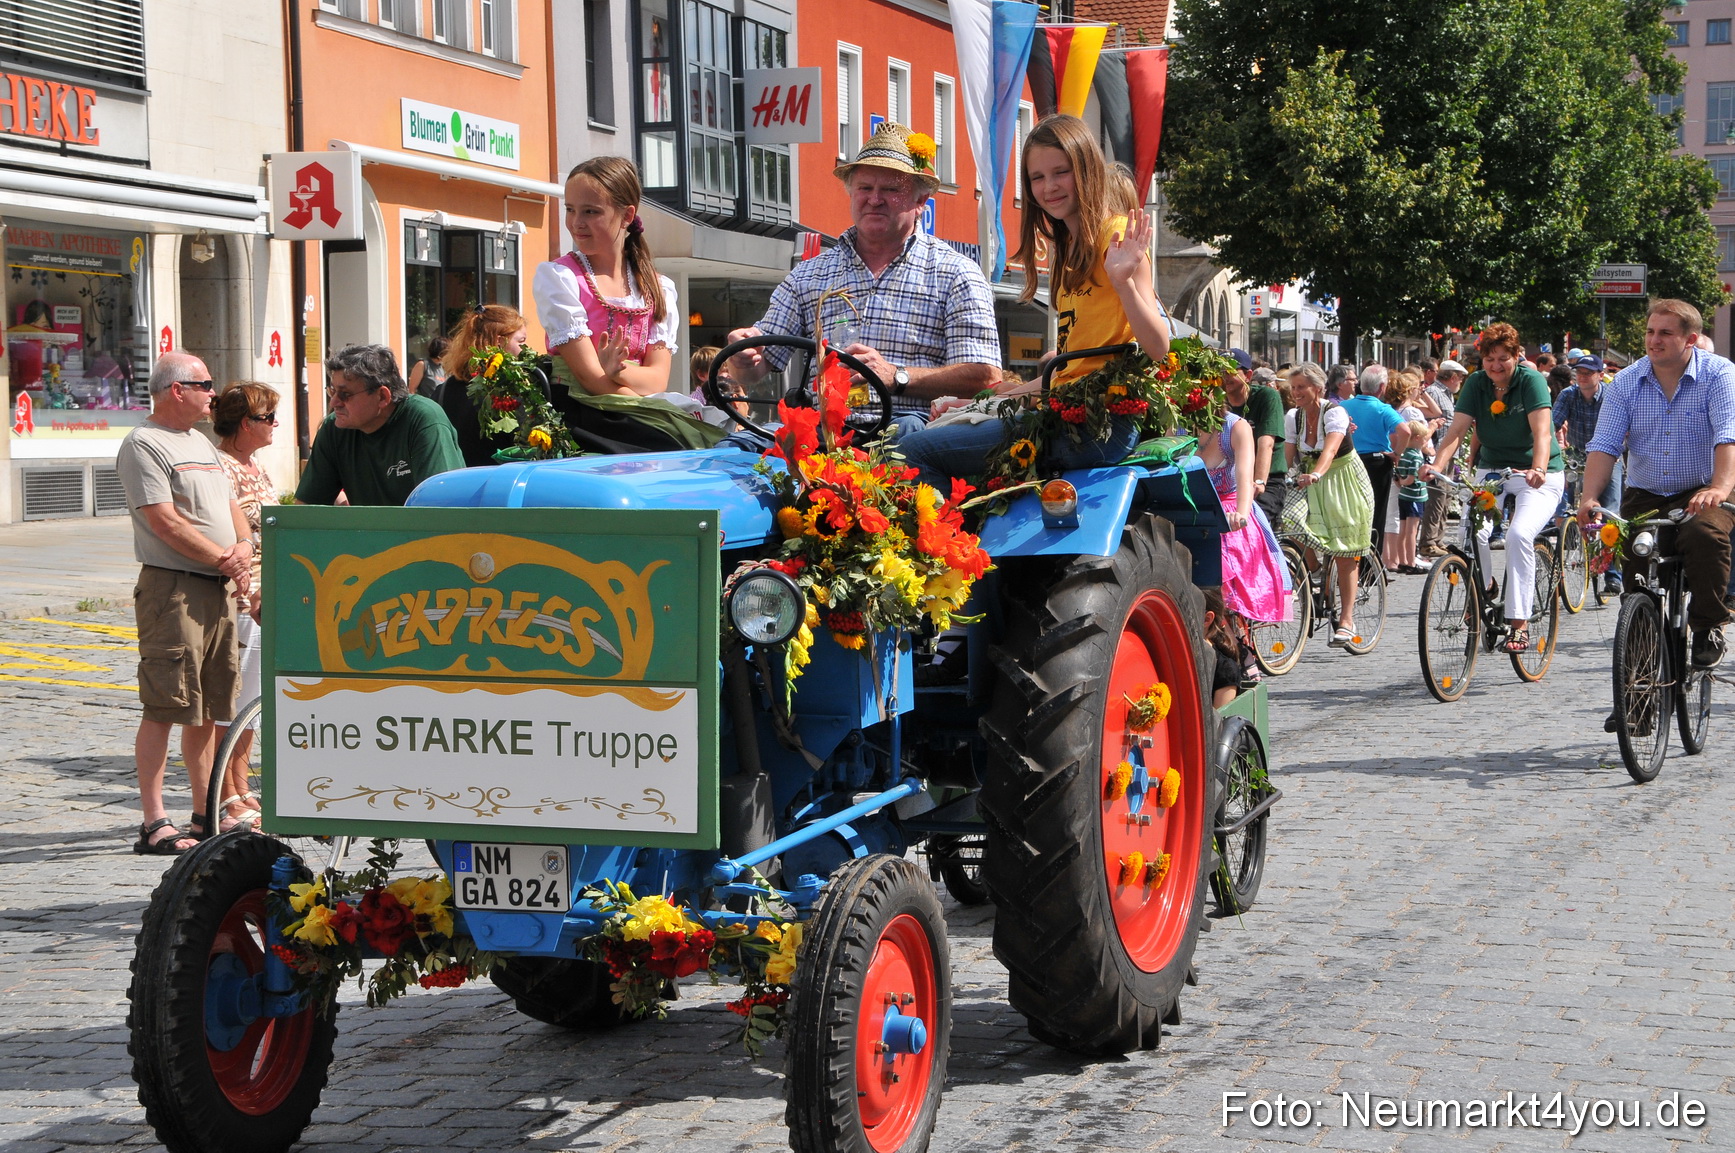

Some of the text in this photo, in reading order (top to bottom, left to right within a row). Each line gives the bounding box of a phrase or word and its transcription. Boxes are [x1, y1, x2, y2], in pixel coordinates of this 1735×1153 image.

[752, 84, 811, 128] H&M
[410, 110, 514, 159] Blumen Grün Punkt
[6, 226, 123, 256] MARIEN APOTHEKE
[52, 419, 65, 431] Ihre
[66, 420, 95, 434] Apotheke
[371, 587, 602, 667] EXPRESS
[288, 714, 678, 768] eine STARKE Truppe
[460, 861, 467, 870] D
[474, 846, 511, 875] NM
[462, 877, 560, 908] GA 824
